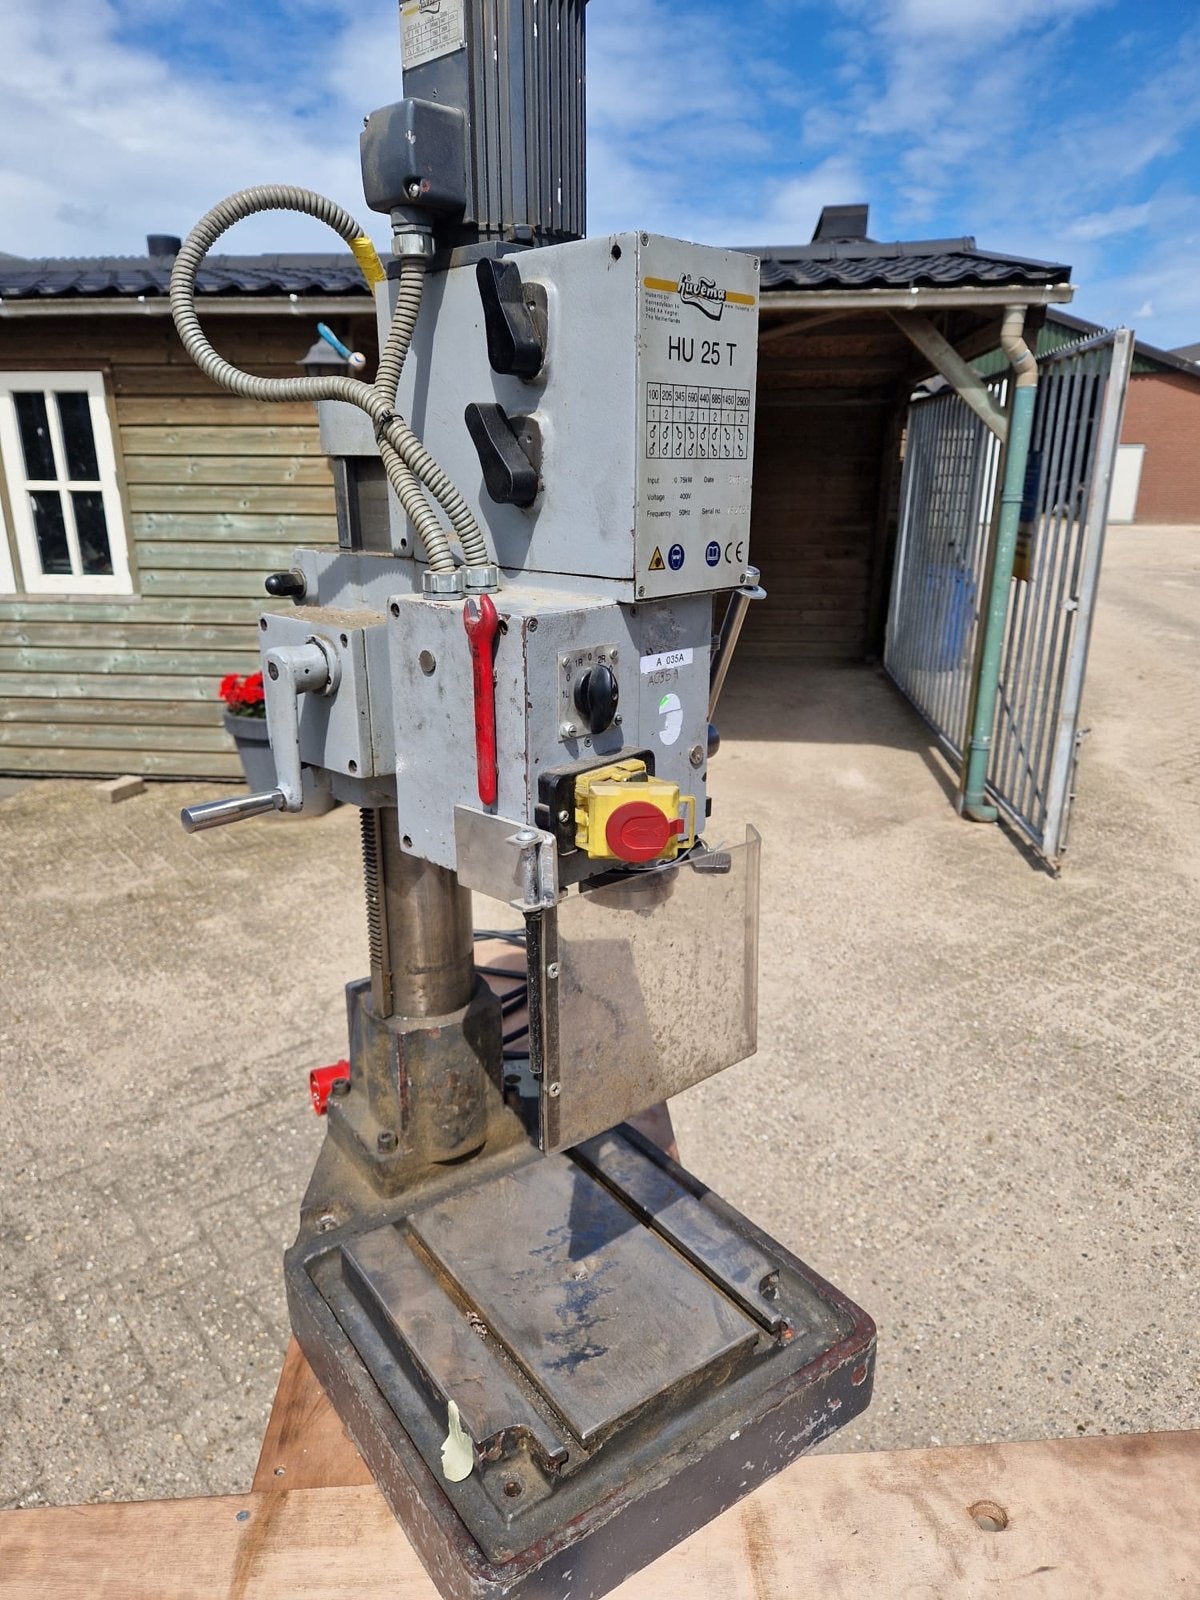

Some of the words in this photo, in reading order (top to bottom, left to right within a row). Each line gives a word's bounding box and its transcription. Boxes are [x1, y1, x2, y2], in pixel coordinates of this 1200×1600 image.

[668, 335, 694, 362] HU
[701, 340, 720, 365] 25
[726, 343, 737, 366] T
[649, 389, 659, 400] 100
[662, 390, 672, 401] 205
[675, 391, 685, 402] 345
[664, 409, 669, 420] 2
[690, 411, 695, 421] 2
[713, 412, 717, 422] 2
[739, 413, 744, 423] 2
[647, 494, 665, 502] Voltage
[647, 510, 671, 518] Frequency
[588, 652, 592, 661] 0
[597, 654, 606, 663] 2R
[656, 658, 662, 666] A
[666, 653, 684, 664] 035A
[575, 659, 583, 668] 1R
[566, 673, 571, 682] 0
